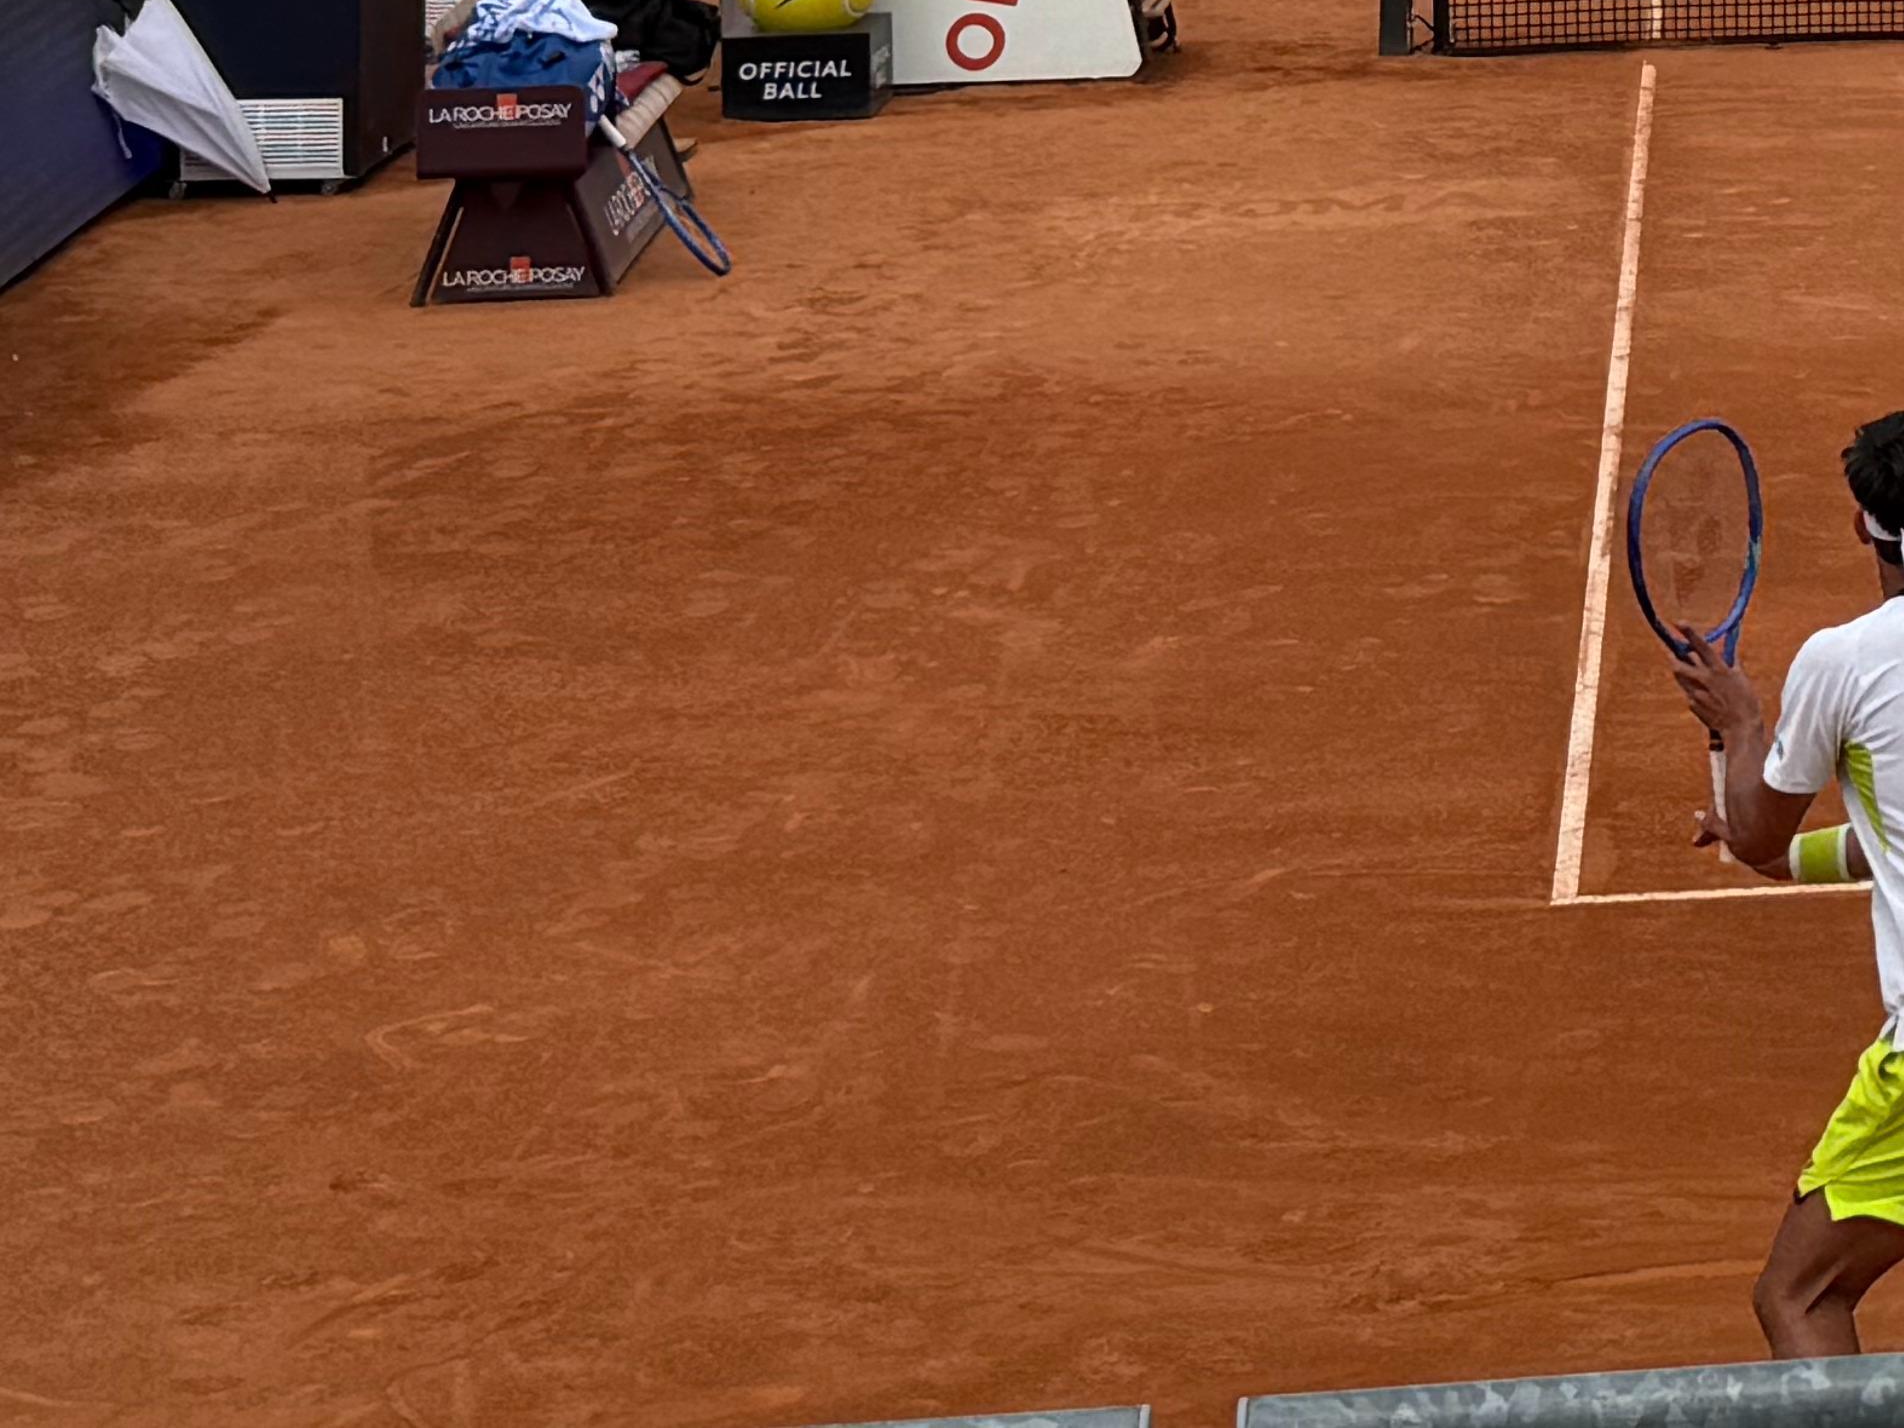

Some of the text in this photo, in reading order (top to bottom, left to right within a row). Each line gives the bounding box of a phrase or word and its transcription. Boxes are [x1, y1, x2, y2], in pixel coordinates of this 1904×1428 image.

[738, 60, 852, 81] OFFICIAL
[763, 82, 823, 100] BALL
[428, 108, 451, 124] LA
[443, 271, 466, 287] LA
